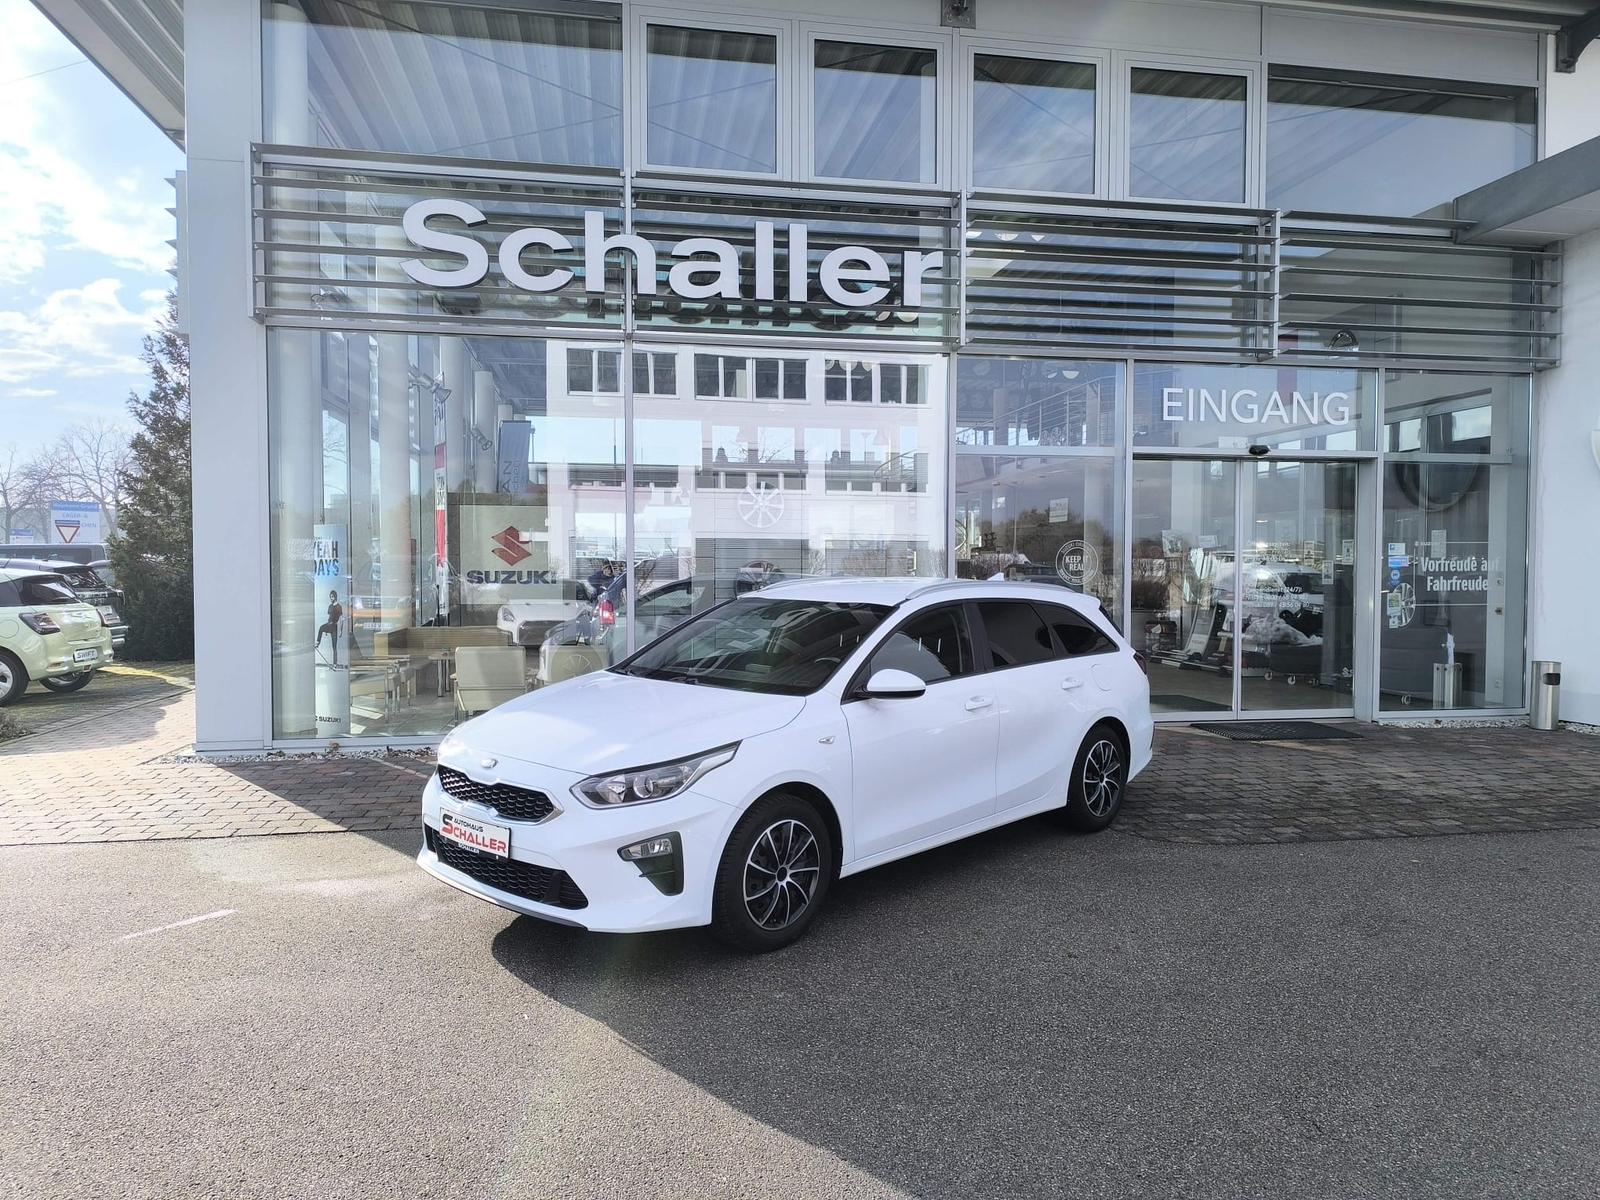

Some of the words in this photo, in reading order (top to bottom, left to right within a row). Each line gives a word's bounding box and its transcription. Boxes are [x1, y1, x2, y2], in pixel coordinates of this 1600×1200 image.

[400, 197, 944, 308] Schaller
[1162, 387, 1350, 426] EINGANG
[1065, 555, 1082, 564] KEEP
[1420, 556, 1477, 572] Vorfreude
[466, 569, 557, 585] SUZUKI
[76, 650, 96, 659] SWIFT
[442, 813, 507, 853] SCHALLER
[453, 818, 484, 833] AUTOHAUS
